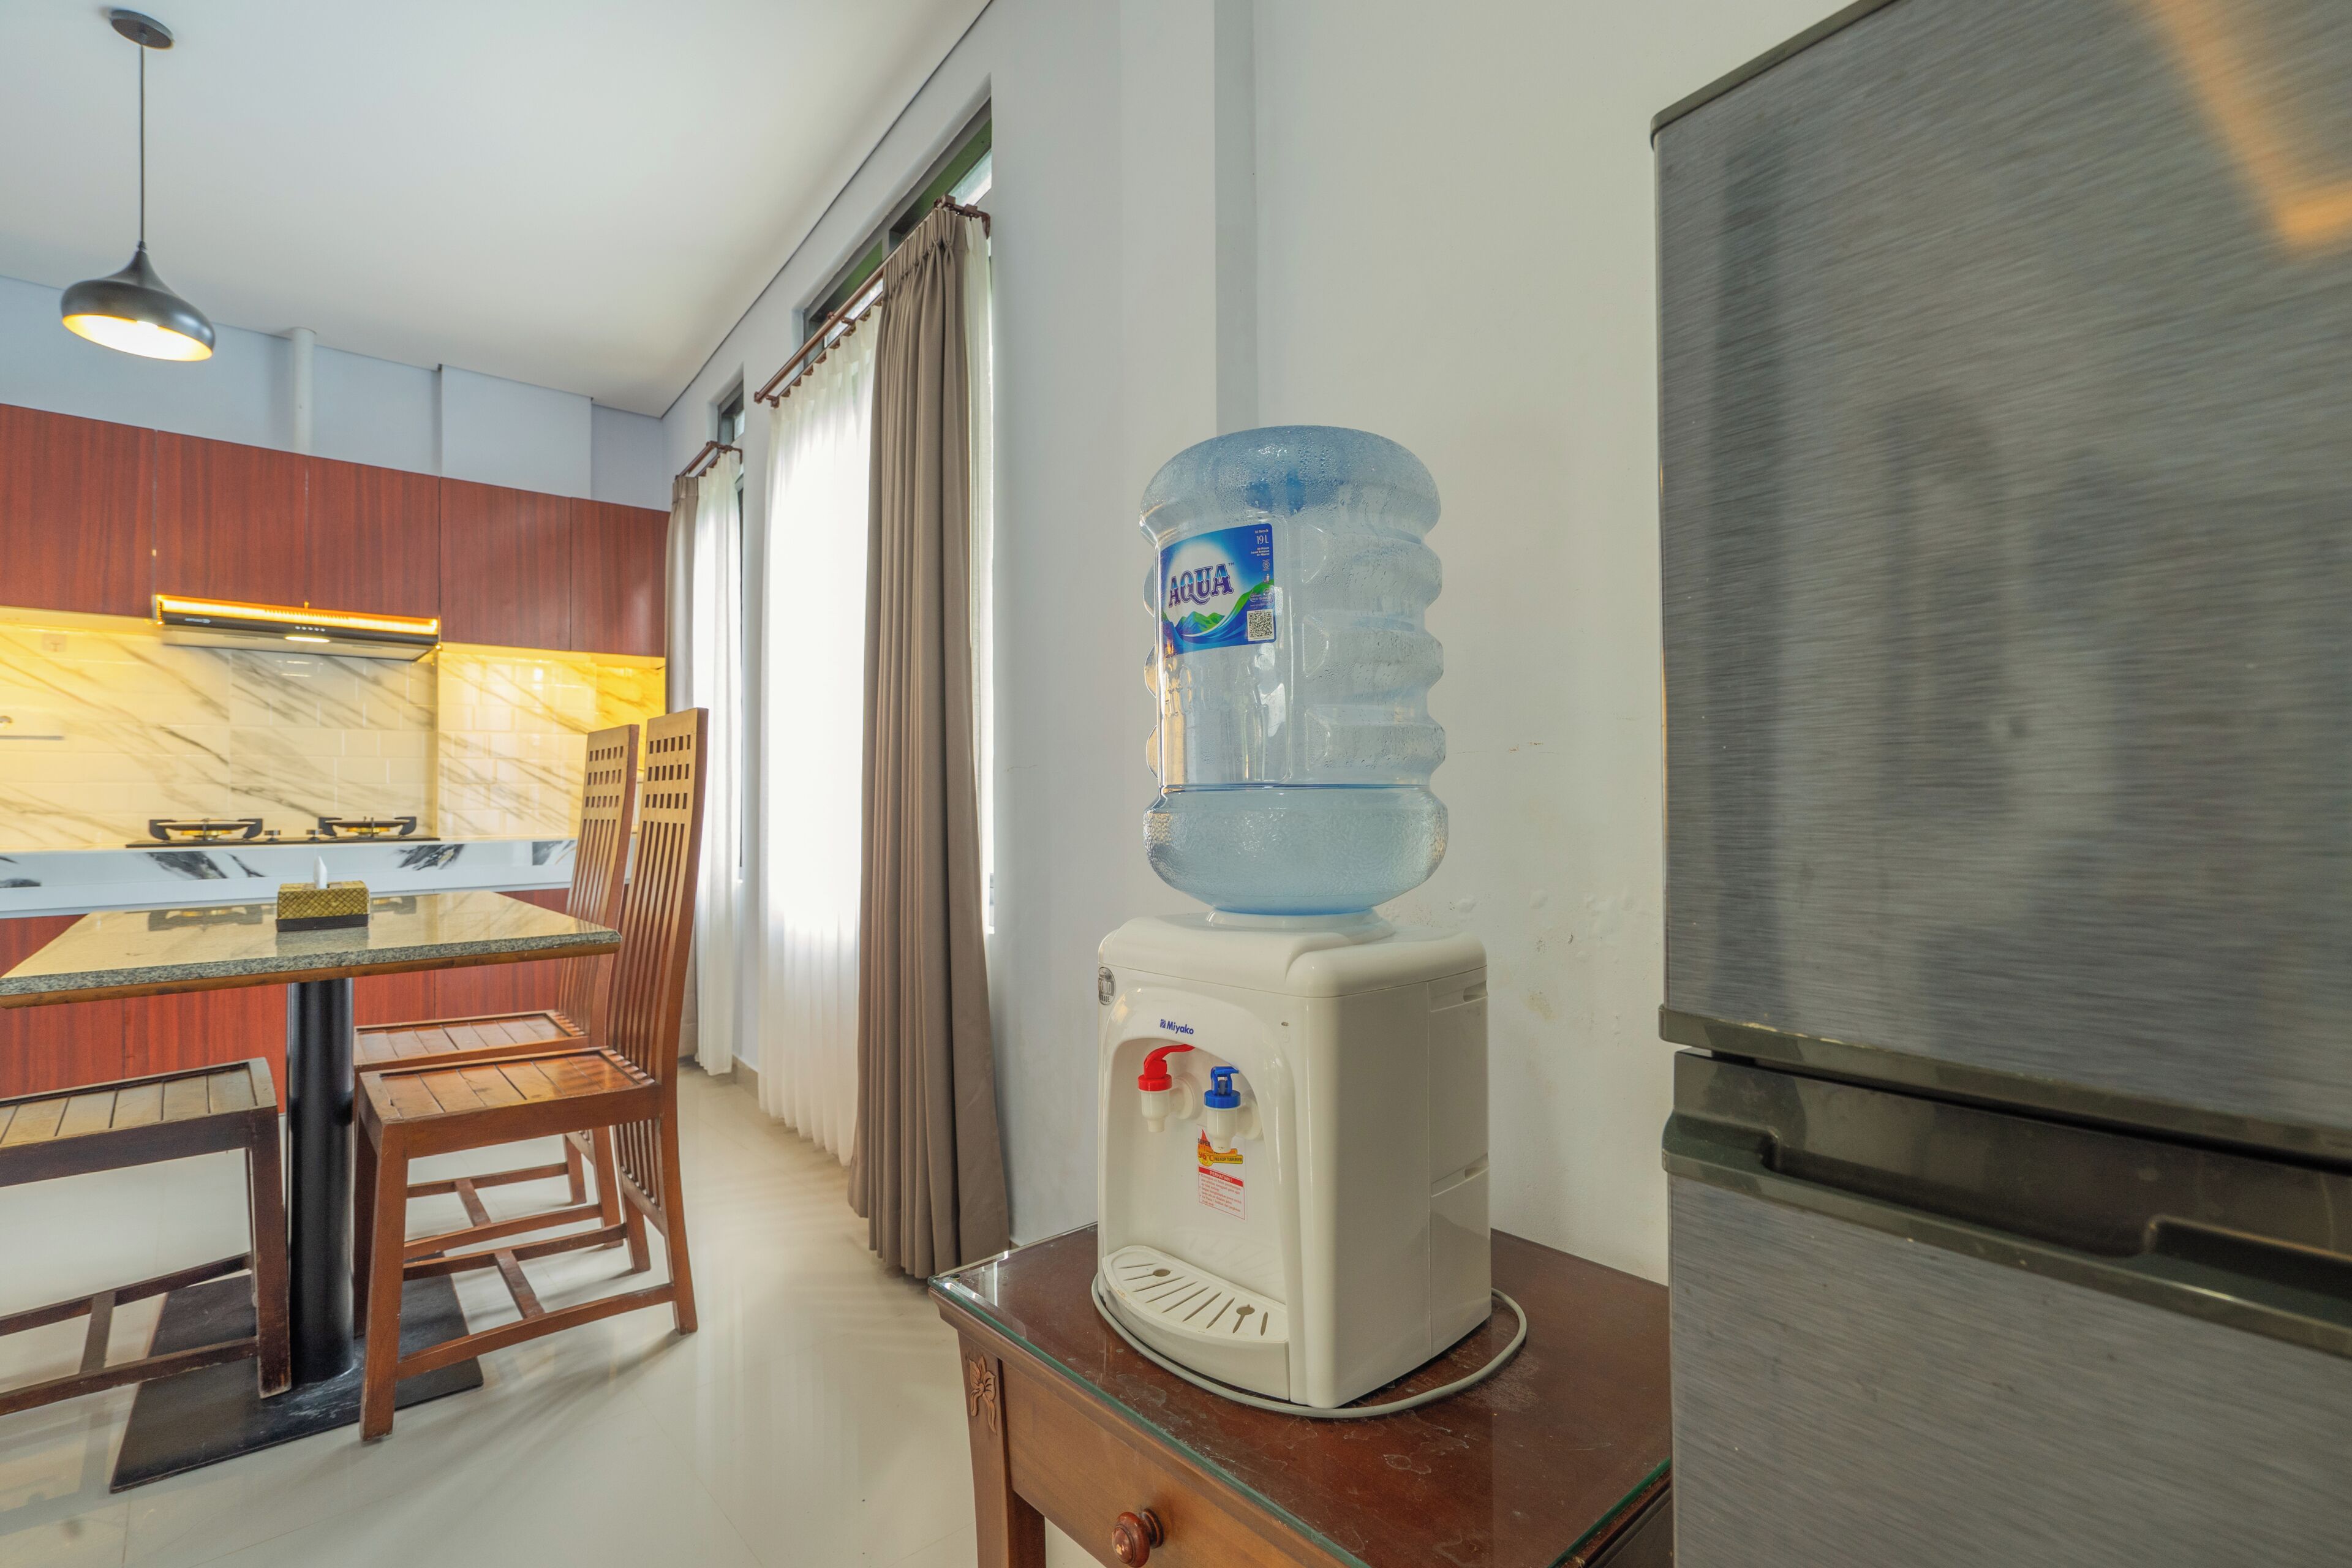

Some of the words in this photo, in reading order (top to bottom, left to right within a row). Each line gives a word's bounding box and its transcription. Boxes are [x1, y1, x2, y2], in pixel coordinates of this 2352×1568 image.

[1256, 535, 1264, 545] 19
[1265, 534, 1269, 543] L
[1169, 564, 1234, 608] AQUA
[1166, 1020, 1194, 1035] Miyako
[1210, 1170, 1231, 1182] PERHATIAN
